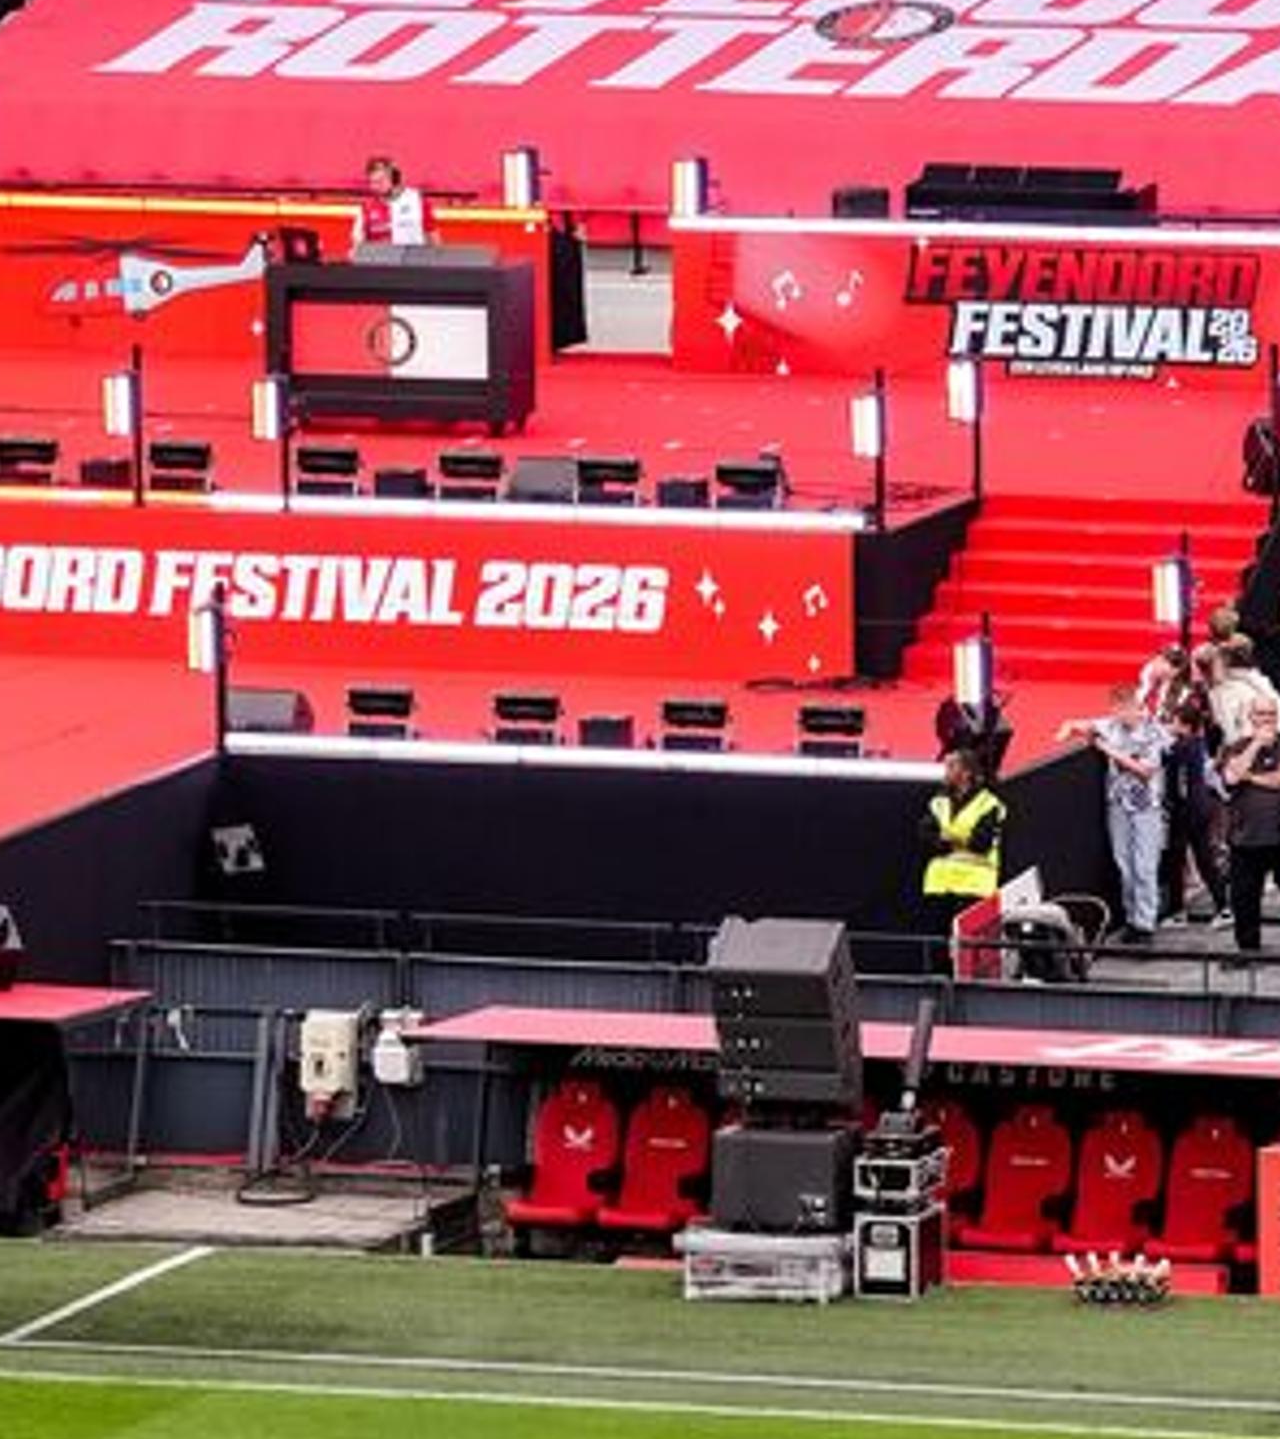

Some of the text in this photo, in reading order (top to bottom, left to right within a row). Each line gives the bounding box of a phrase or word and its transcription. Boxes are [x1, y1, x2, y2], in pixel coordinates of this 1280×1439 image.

[910, 247, 1258, 309] FEYENOORD
[950, 301, 1214, 362] FESTIVAL
[475, 560, 670, 631] 2026
